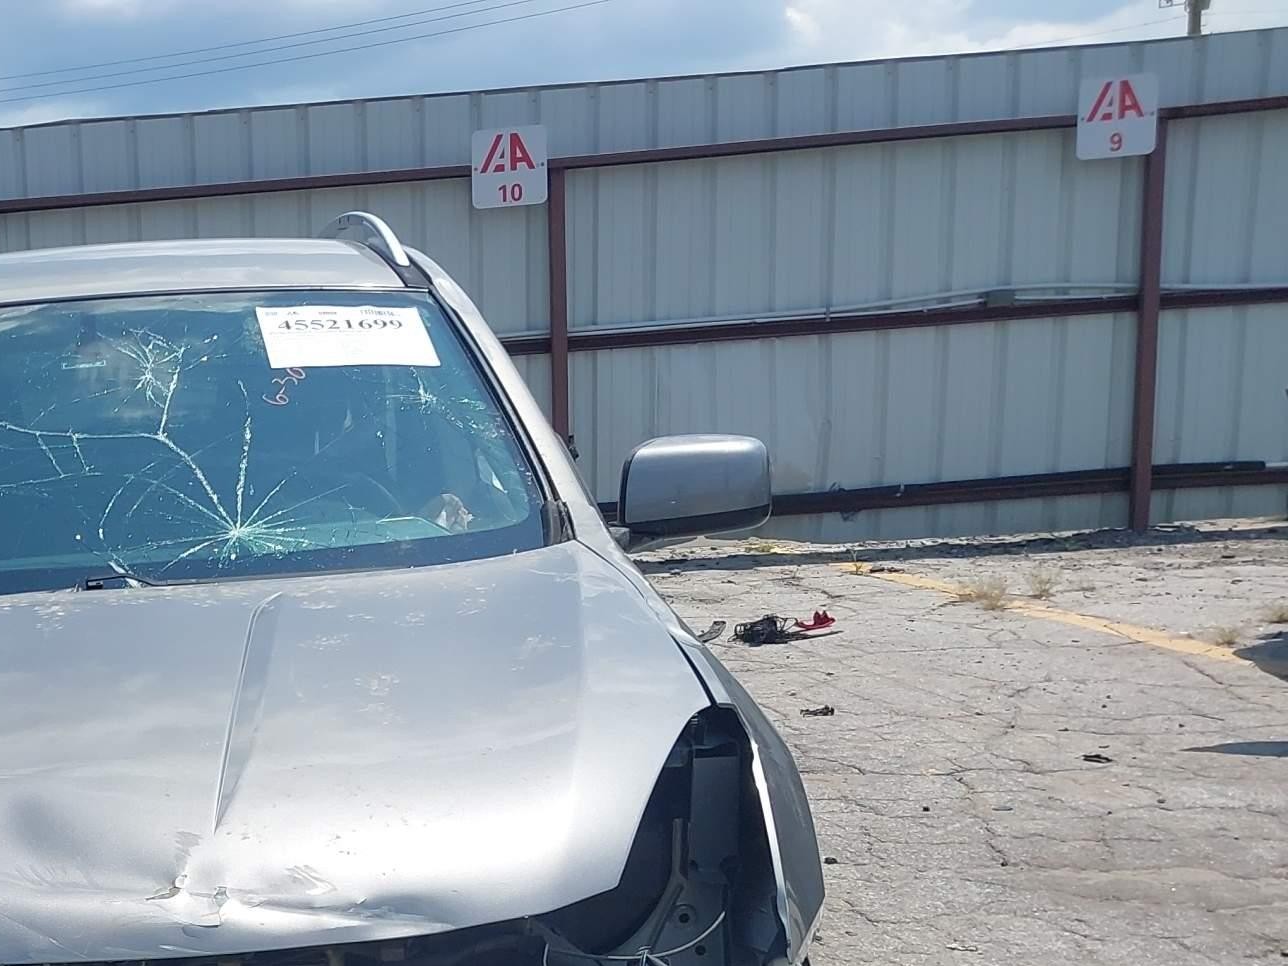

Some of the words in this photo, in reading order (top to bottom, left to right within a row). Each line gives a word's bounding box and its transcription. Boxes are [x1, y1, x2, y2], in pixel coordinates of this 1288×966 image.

[1108, 132, 1123, 153] 9
[497, 184, 523, 203] 10
[278, 319, 403, 331] 45521699
